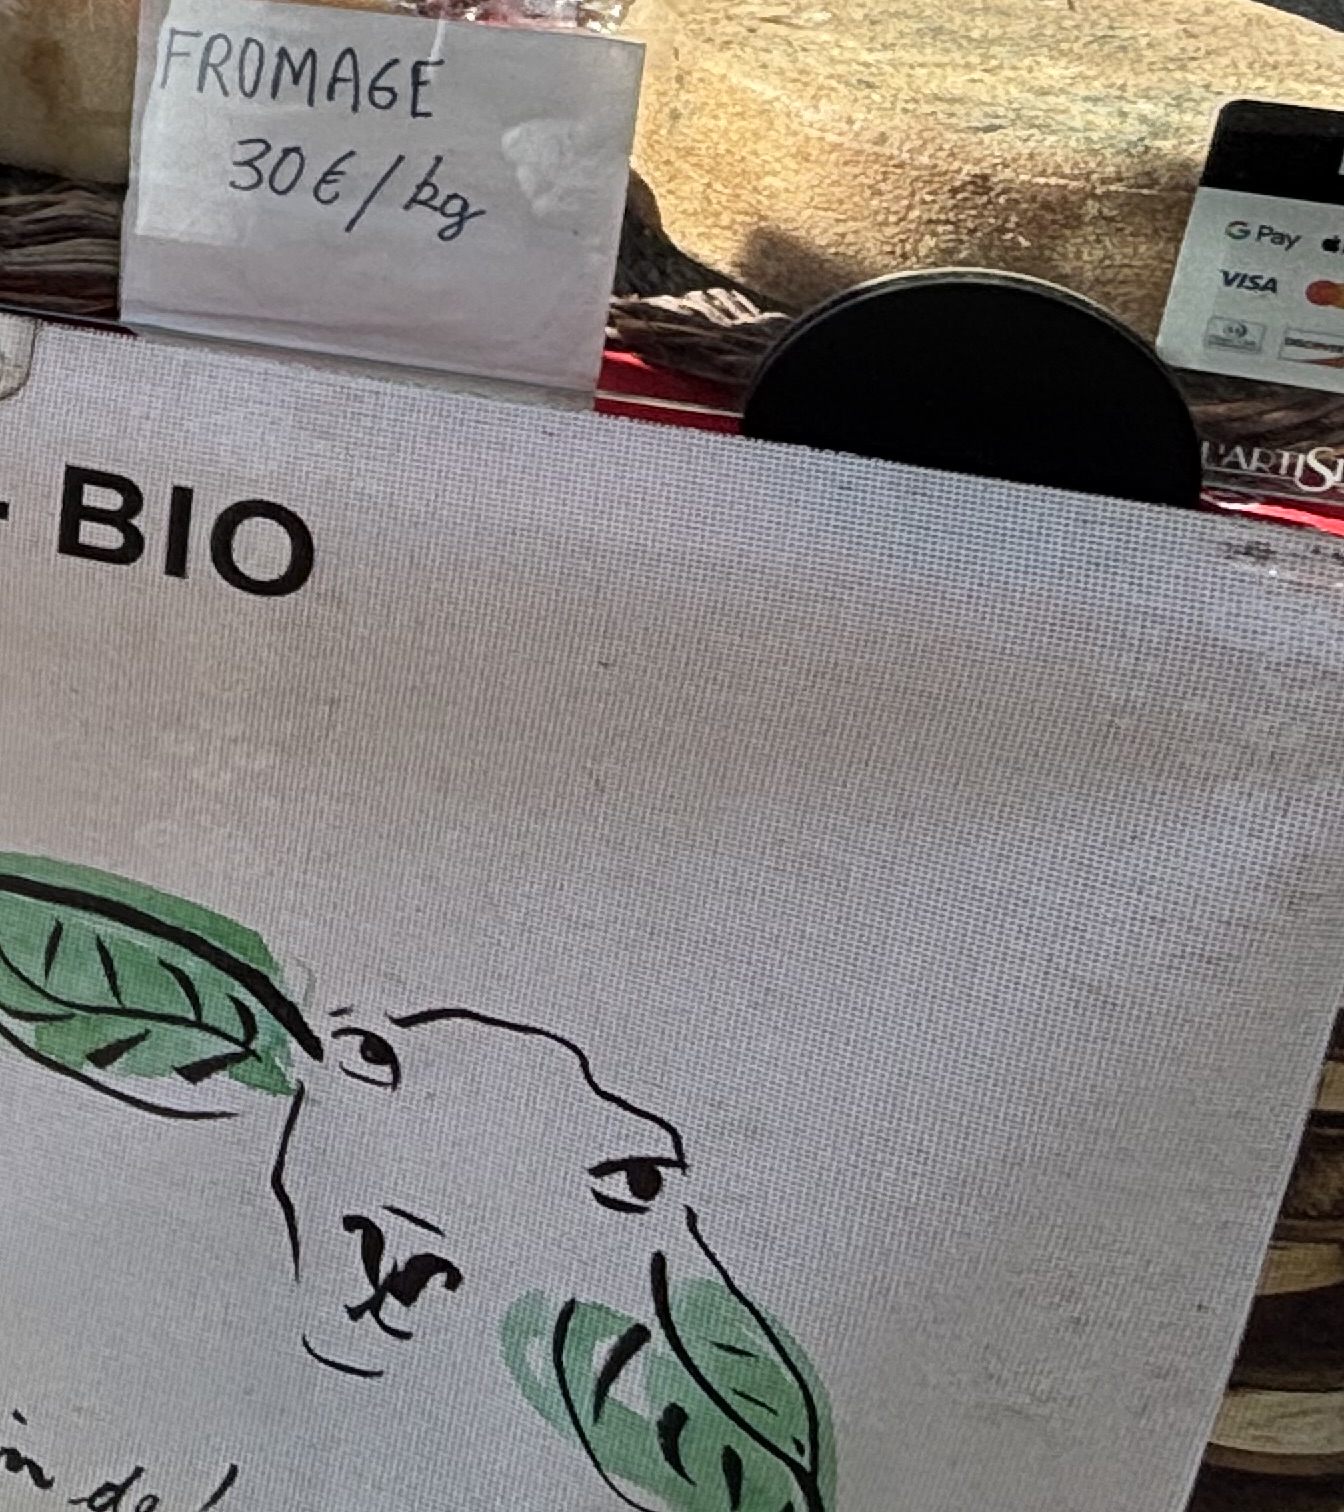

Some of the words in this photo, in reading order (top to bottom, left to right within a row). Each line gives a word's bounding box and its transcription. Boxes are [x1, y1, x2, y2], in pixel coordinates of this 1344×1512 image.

[159, 26, 445, 119] FROMAGE
[1255, 224, 1303, 252] Pay
[1218, 268, 1278, 294] VISA
[57, 462, 315, 598] BIO
